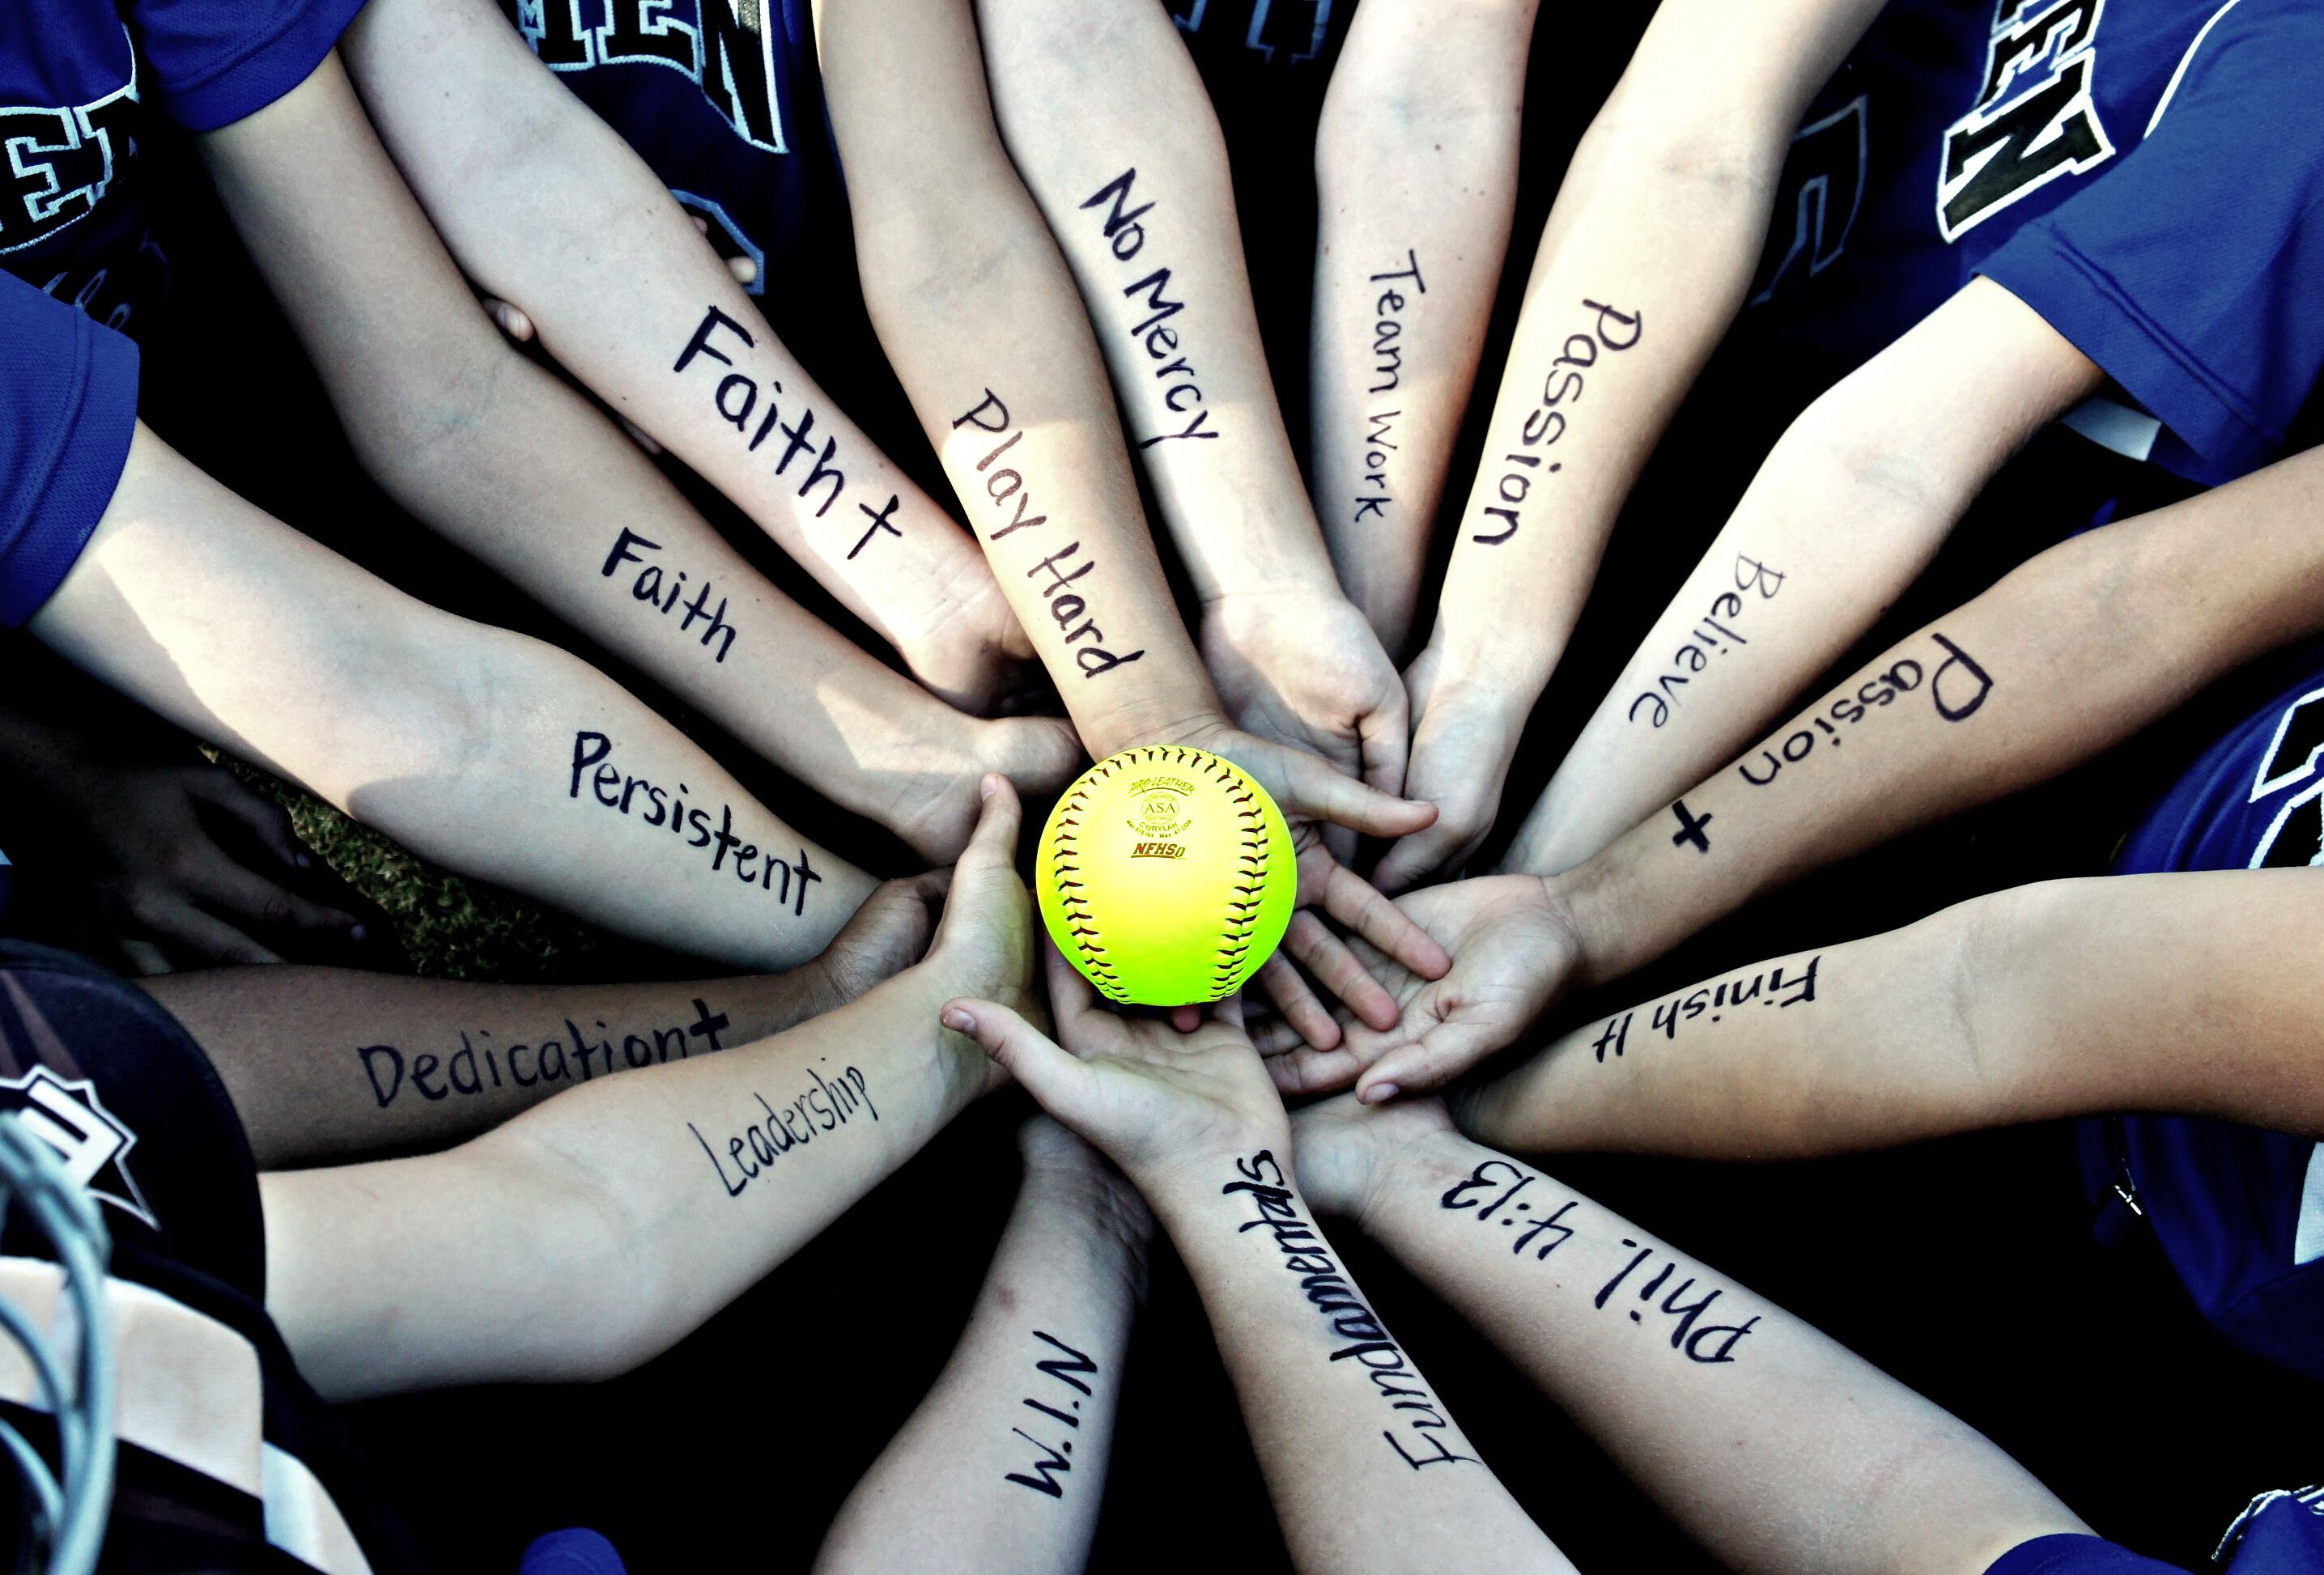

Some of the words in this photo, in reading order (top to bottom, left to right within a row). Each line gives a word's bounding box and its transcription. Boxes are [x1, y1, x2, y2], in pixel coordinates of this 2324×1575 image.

[1078, 167, 1156, 261] No
[1124, 268, 1219, 448] Mercy
[1369, 249, 1425, 393] Team
[673, 304, 844, 517] Faith
[1355, 410, 1401, 523] Work
[1472, 299, 1642, 545] Passion
[601, 527, 737, 663] Faith
[952, 388, 1047, 540] Play
[1027, 541, 1145, 679] Hard
[1629, 551, 1786, 728] Believe
[1739, 632, 1994, 786] Passion
[570, 731, 822, 916] Persistent
[1145, 802, 1176, 813] ASA
[1651, 955, 1821, 1038] Finish
[687, 1058, 880, 1197] Leadership
[1441, 1160, 1579, 1260] 4:13
[1222, 1149, 1482, 1470] Fundamentals
[1594, 1238, 1761, 1363] Phil.
